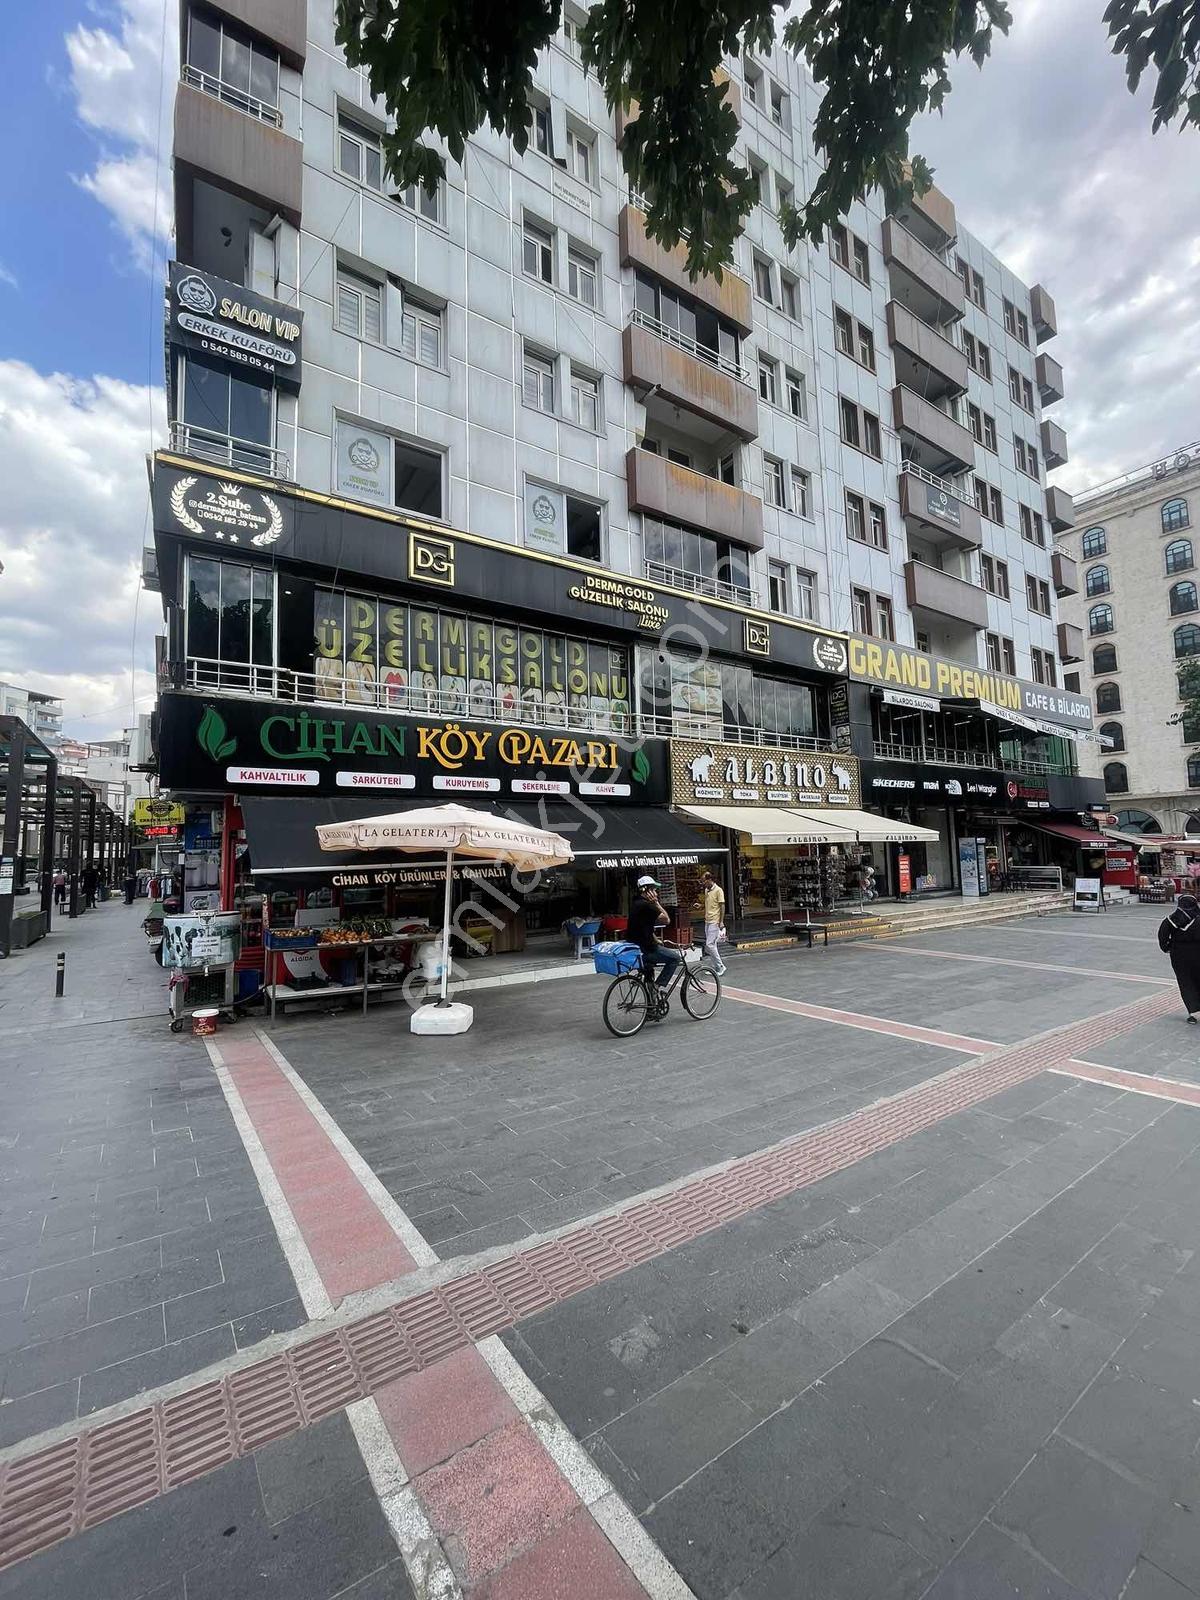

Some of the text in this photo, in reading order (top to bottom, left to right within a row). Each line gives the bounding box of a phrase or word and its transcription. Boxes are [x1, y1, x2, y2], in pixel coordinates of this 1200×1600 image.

[219, 297, 300, 341] SALON VIP
[184, 318, 292, 361] ERKEK KUAFÖRÜ
[209, 342, 229, 356] 542
[249, 356, 262, 368] 05
[263, 362, 275, 372] 44
[1151, 448, 1200, 479] HO
[417, 547, 448, 572] DG
[569, 586, 669, 618] GÜZELLİK SALONU
[750, 628, 768, 645] DG
[849, 638, 1022, 710] GRAND PREMIUM
[1025, 691, 1091, 719] CAFE & BİLARDO
[260, 711, 619, 769] CİHAN KÖY PAZARI
[240, 770, 307, 782] KAHVALTILIK
[445, 779, 489, 790] KURUYEMİŞ
[872, 778, 916, 789] SKECHERS
[923, 780, 940, 790] mavi
[522, 782, 561, 792] ŞEKERLEME
[595, 785, 615, 793] KAHVE
[364, 828, 449, 838] LA GELATERIA
[476, 830, 490, 838] LA
[494, 831, 546, 848] GELATERIA
[596, 855, 699, 868] CİHAN KÖY ÜRÜNLERİ & KAHVALTI
[332, 867, 506, 886] CİHAN KÖY ÜRÜNLER & KAHVALTI
